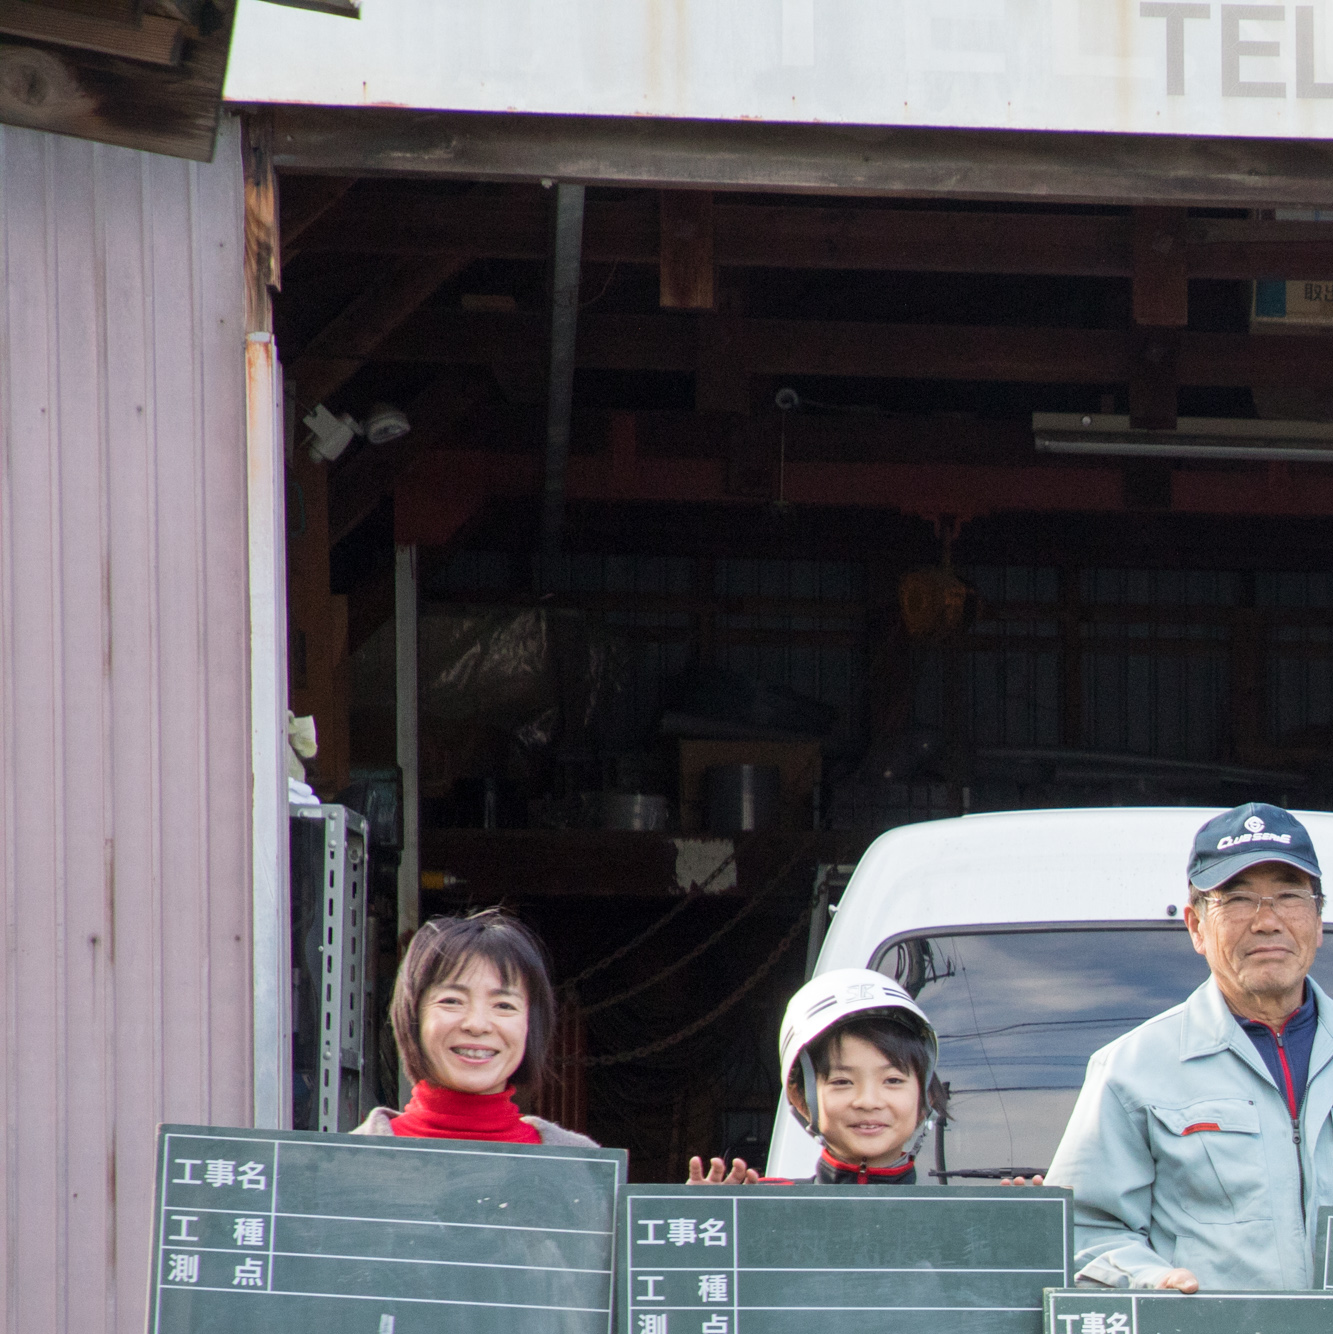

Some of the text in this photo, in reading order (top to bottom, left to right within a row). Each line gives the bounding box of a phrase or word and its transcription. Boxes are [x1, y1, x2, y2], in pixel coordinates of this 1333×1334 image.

[173, 1157, 267, 1191] 工事名
[637, 1217, 728, 1248] 工事名
